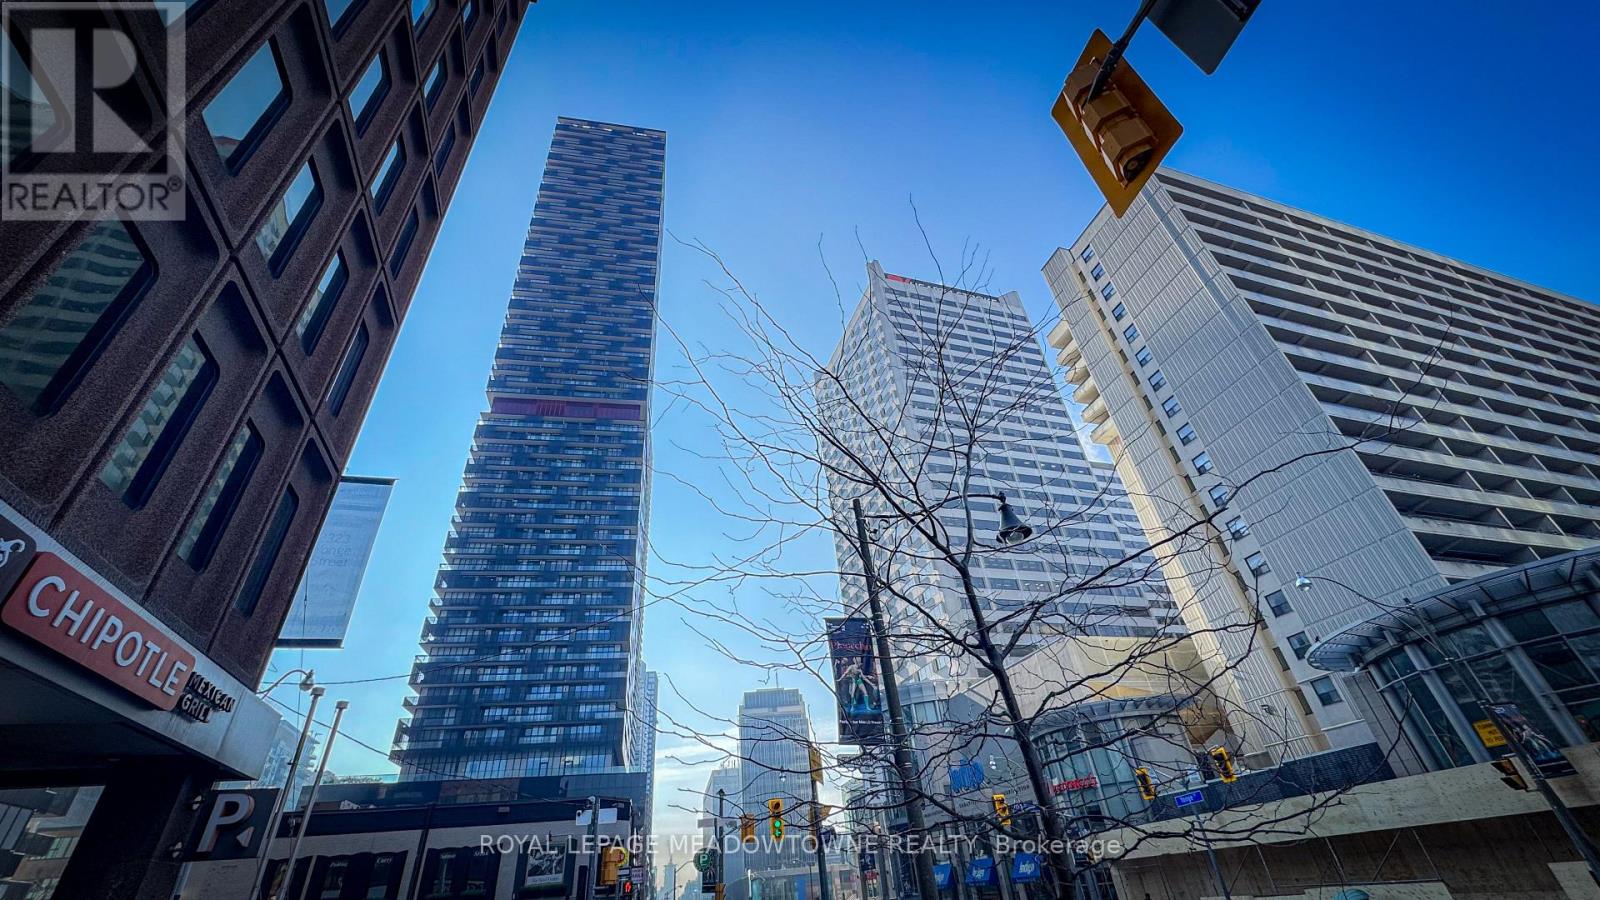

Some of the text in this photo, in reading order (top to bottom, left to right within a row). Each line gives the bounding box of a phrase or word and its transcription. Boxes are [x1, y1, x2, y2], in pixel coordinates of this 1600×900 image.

[27, 575, 187, 696] CHIPOTLE
[180, 693, 212, 723] GRILL
[187, 672, 236, 713] MEXICAN
[196, 793, 254, 852] P
